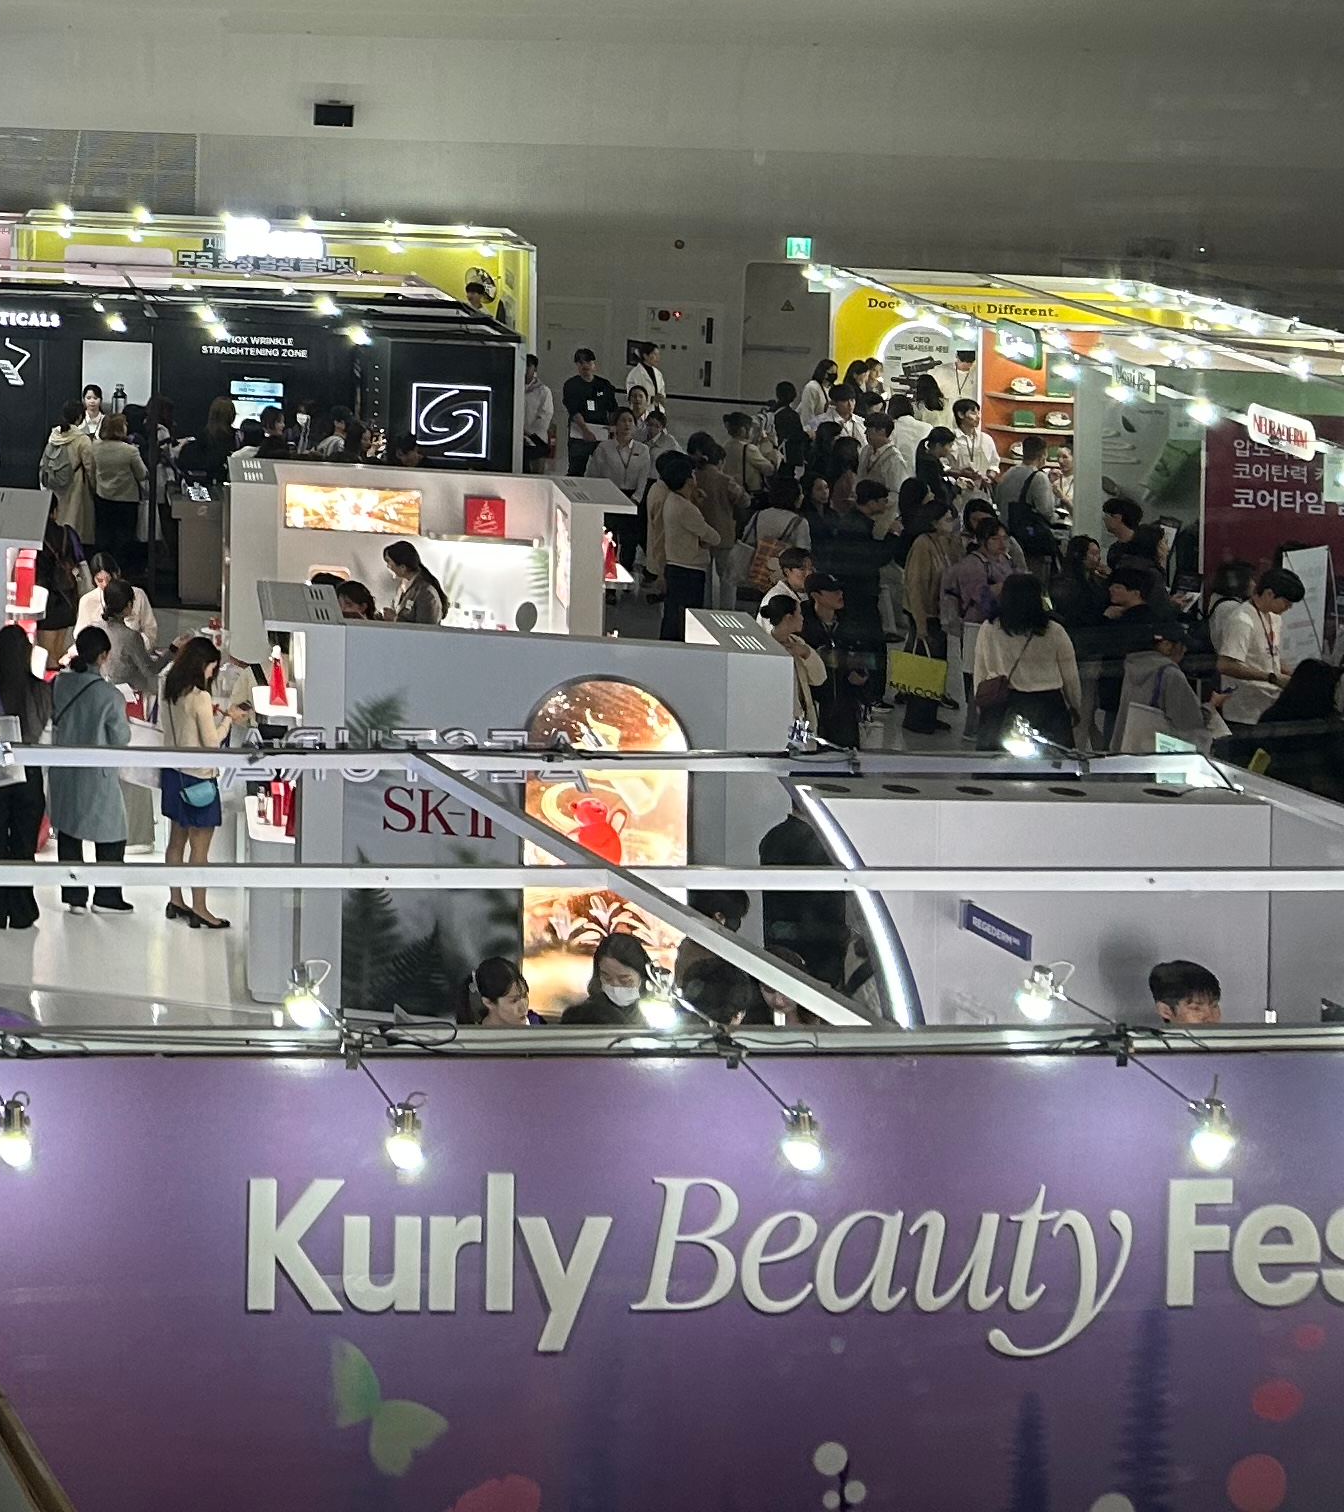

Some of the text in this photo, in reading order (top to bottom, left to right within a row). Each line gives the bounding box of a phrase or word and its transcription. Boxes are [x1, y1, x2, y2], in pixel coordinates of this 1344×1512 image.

[986, 304, 1059, 318] Different.
[250, 336, 294, 347] WRINKLE
[201, 345, 308, 358] STRAIGHTENING ZONE
[1232, 462, 1308, 484] 코어탄력
[1231, 488, 1325, 515] 코어타임
[244, 1171, 615, 1354] Kurly
[628, 1175, 1132, 1358] Beauty
